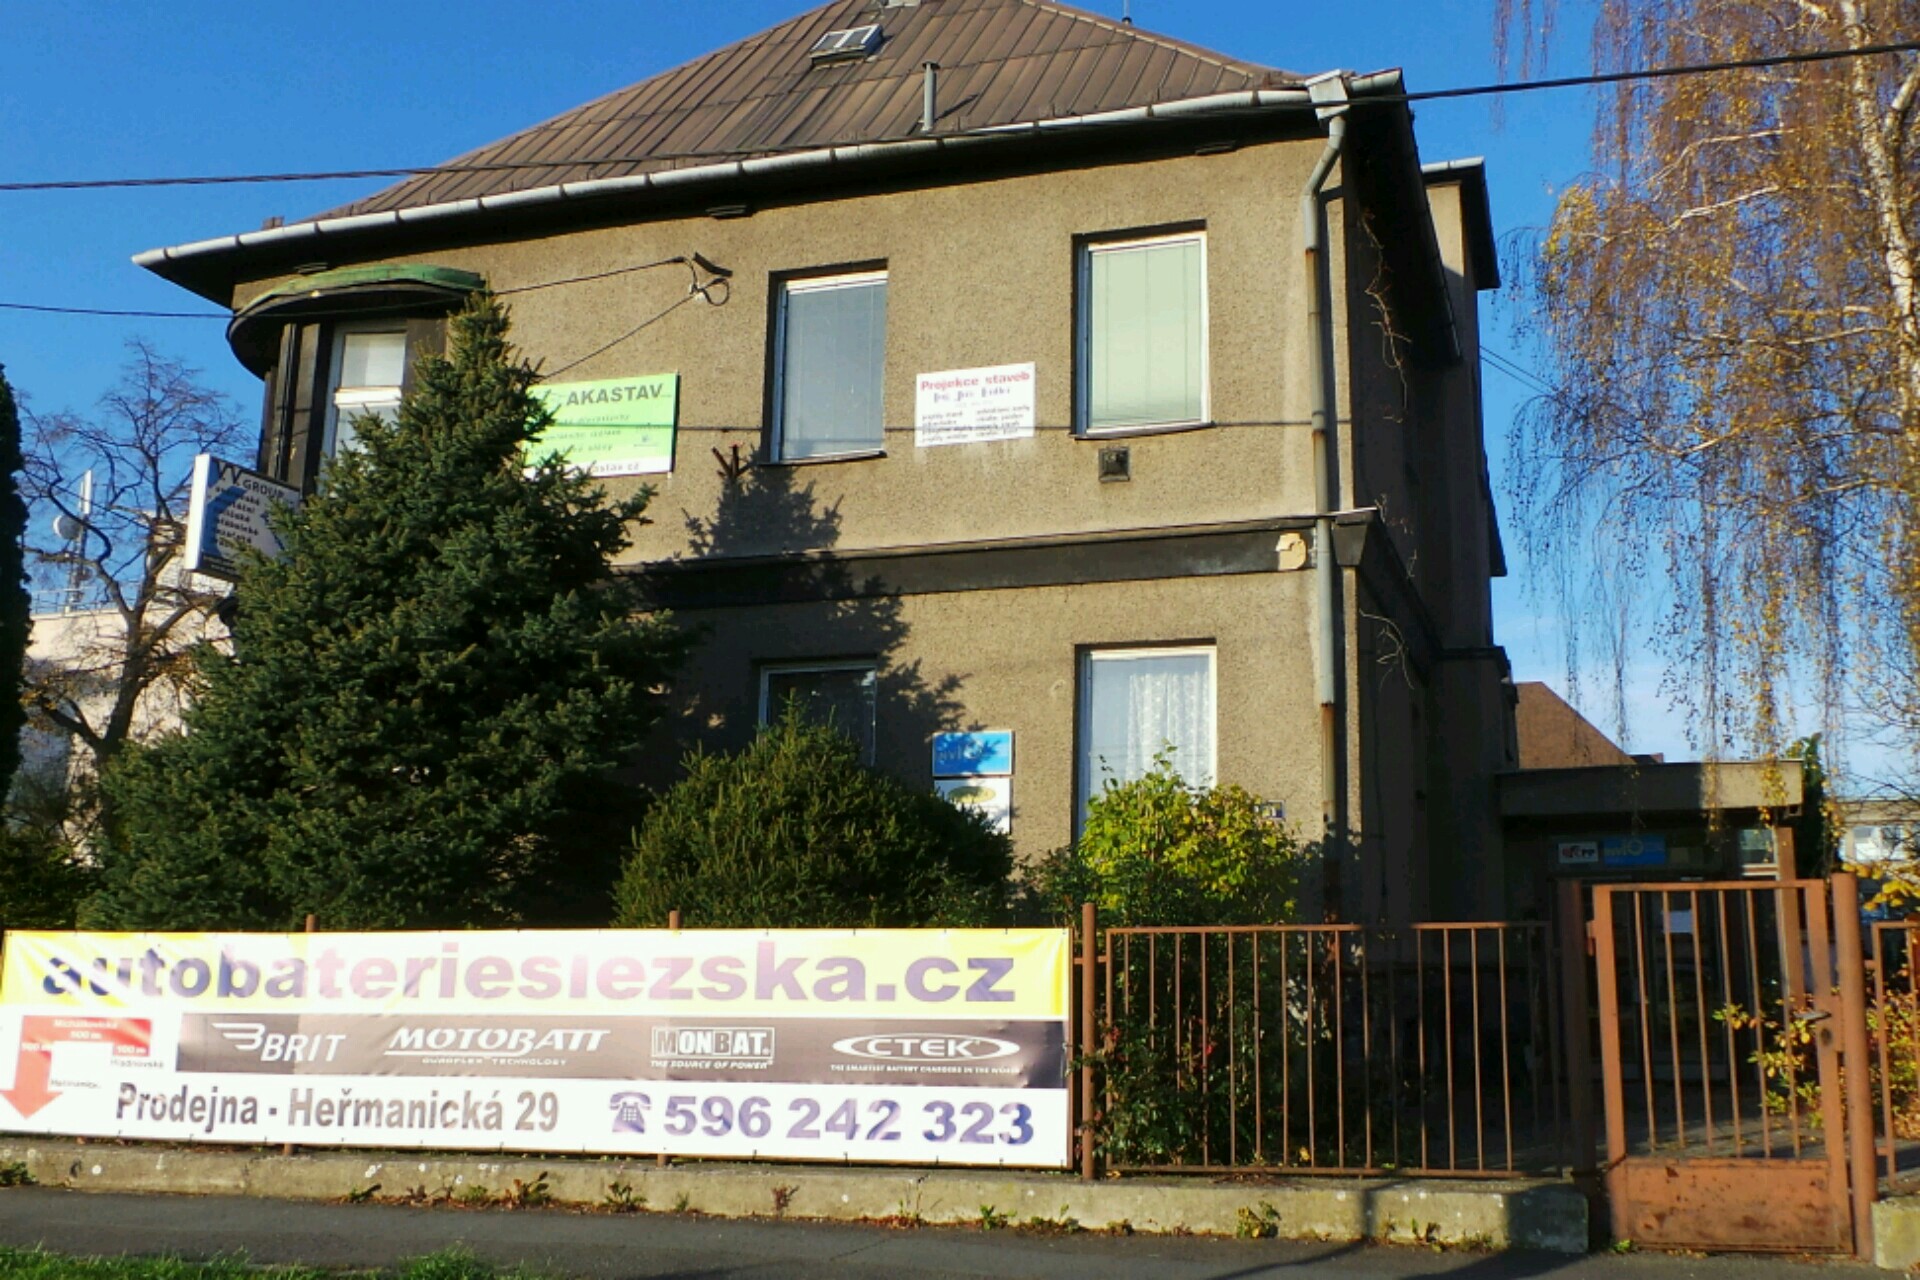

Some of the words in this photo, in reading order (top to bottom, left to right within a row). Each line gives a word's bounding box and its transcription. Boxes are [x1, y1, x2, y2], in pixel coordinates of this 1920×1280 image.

[566, 383, 663, 406] AKASTAV
[260, 1033, 347, 1062] BRIT
[385, 1026, 611, 1057] MOTOBATT
[866, 1038, 973, 1057] CTEK
[116, 1082, 258, 1133] Prodejna
[288, 1088, 502, 1131] Heřmanická
[515, 1090, 559, 1132] 29
[663, 1095, 772, 1138] 596
[786, 1097, 902, 1141] 242
[922, 1101, 1034, 1145] 323
